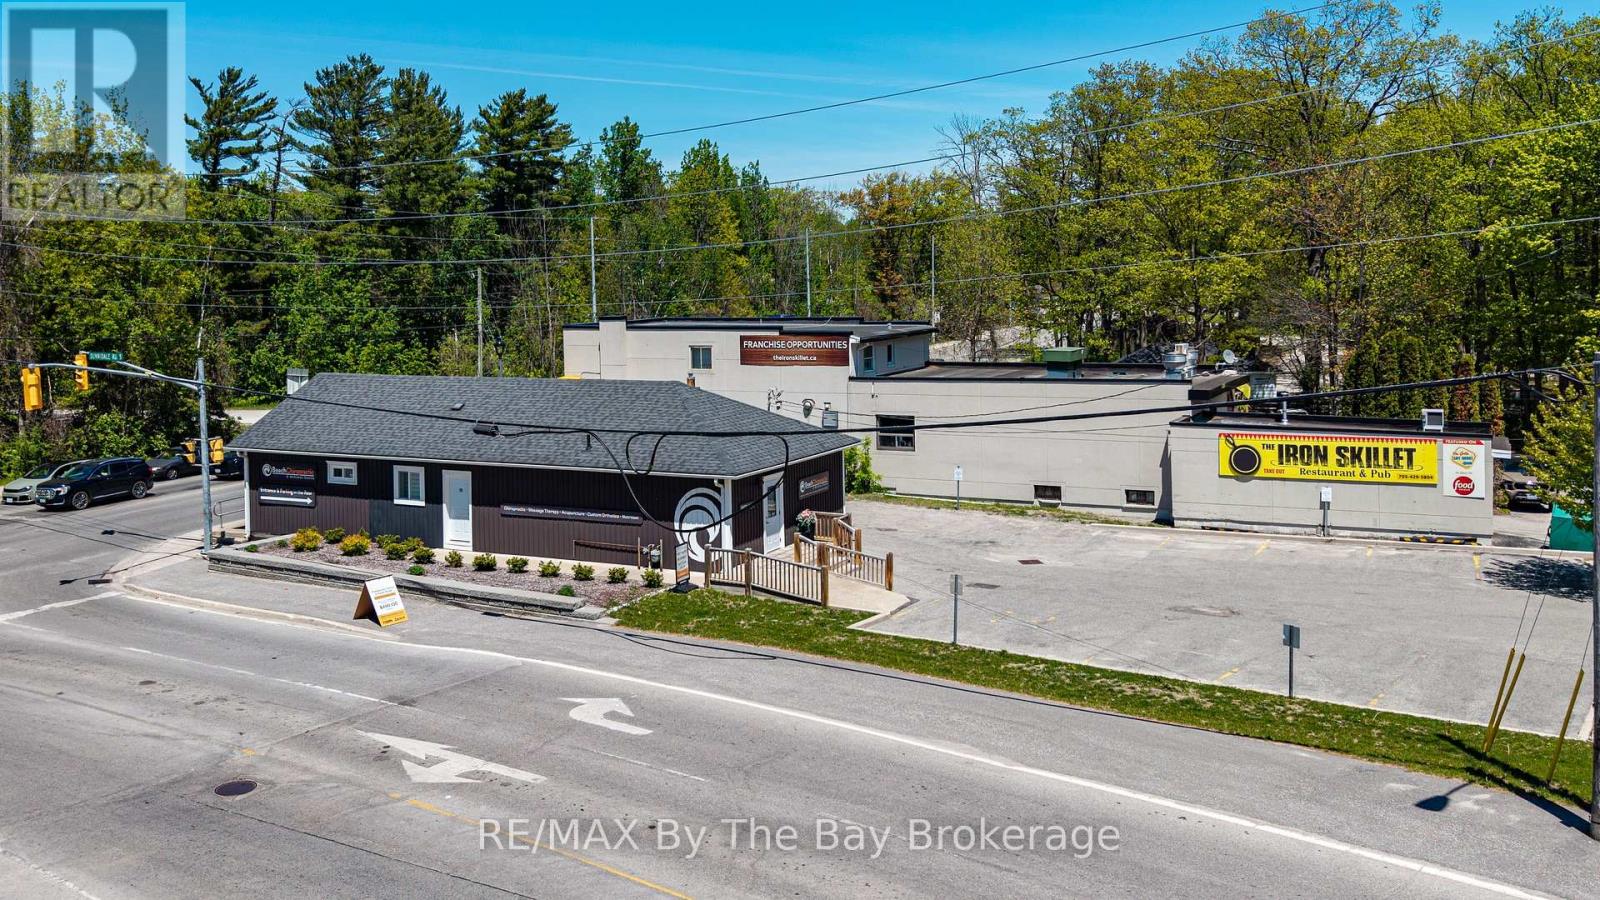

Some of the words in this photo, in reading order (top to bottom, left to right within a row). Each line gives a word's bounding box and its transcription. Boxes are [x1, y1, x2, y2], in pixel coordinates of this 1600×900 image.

[743, 340, 786, 349] FRANCHISE
[786, 340, 848, 349] OPPORTUNITIES
[1277, 443, 1329, 467] IRON
[1335, 445, 1417, 471] SKILLET
[1299, 467, 1356, 478] Restaurant
[1359, 470, 1367, 478] &
[1371, 470, 1391, 479] Pub
[1454, 479, 1474, 491] food
